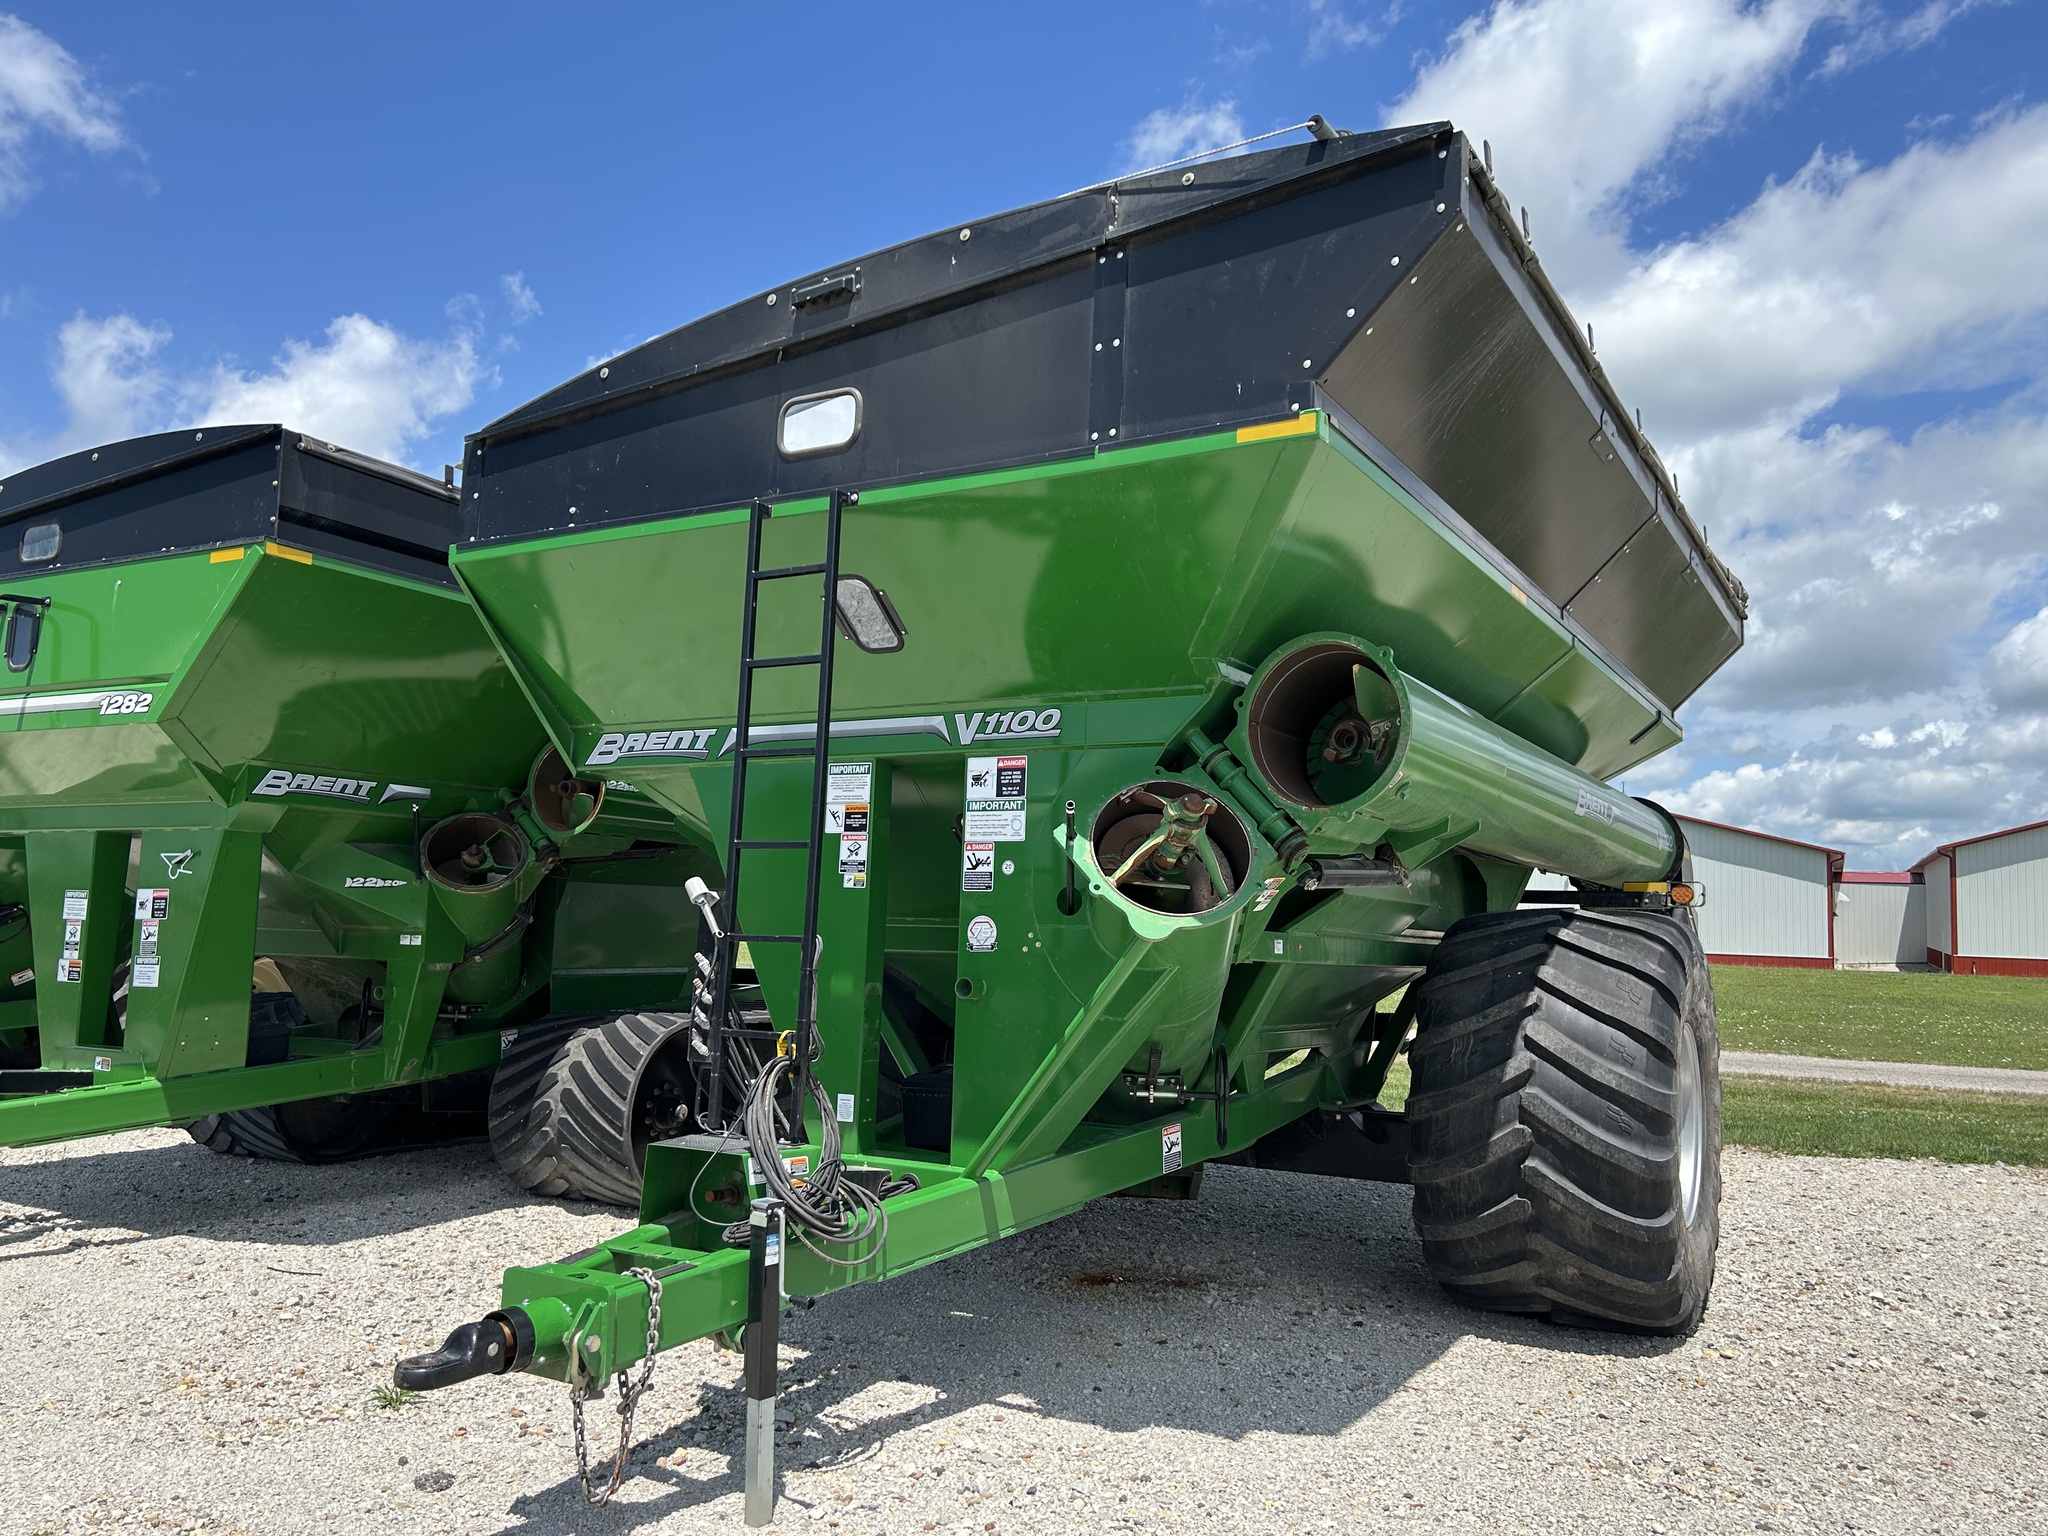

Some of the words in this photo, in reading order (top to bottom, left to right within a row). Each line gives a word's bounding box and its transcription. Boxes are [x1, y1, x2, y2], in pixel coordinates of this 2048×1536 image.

[99, 693, 153, 715] 1282
[955, 708, 1062, 746] V1100
[584, 728, 718, 766] BRENT
[830, 765, 869, 774] IMPORTANT
[251, 769, 378, 797] BRENT
[969, 801, 1023, 811] IMPORTANT
[1575, 788, 1608, 817] BRENT
[973, 924, 992, 938] 75
